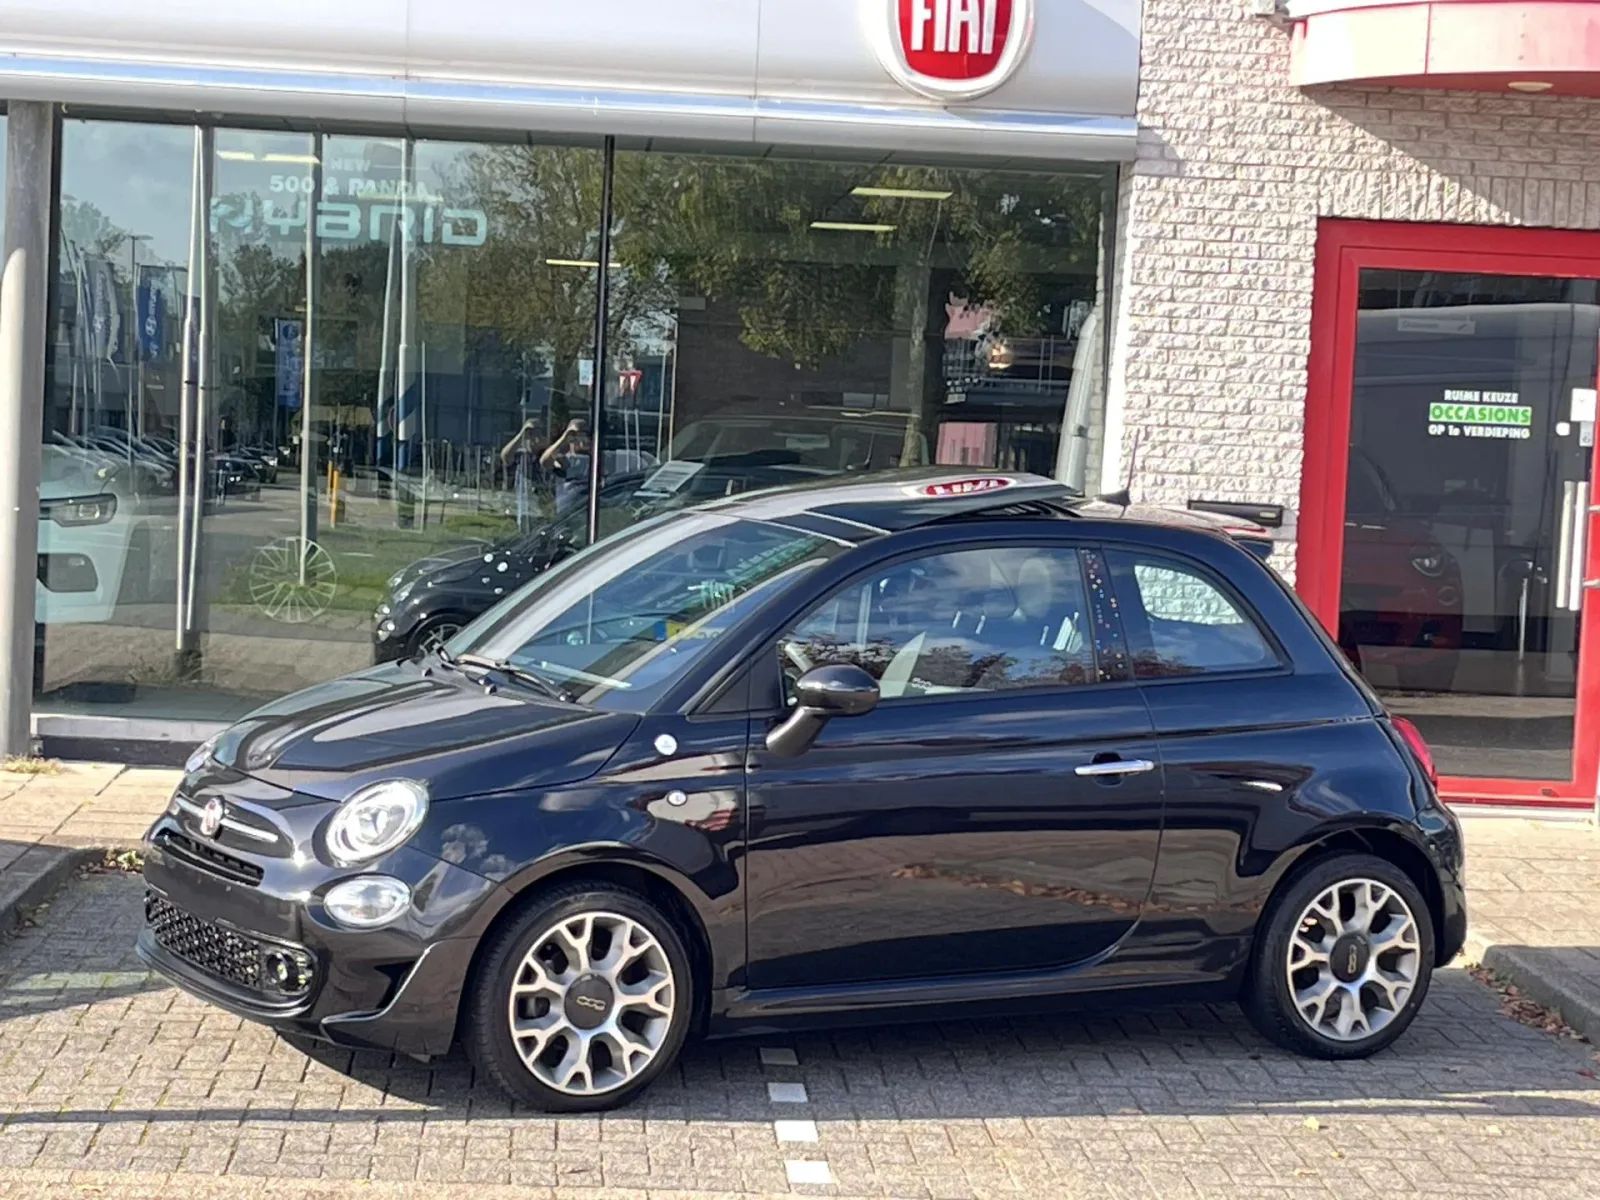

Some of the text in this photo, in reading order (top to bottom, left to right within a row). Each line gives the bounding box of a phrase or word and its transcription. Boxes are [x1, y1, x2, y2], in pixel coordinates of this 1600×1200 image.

[911, 0, 997, 54] FIAT
[331, 157, 371, 172] NEW
[269, 174, 429, 200] 500 & PANDA
[1444, 389, 1519, 403] RUIME KEUZE
[1431, 404, 1529, 423] OCCASIONS
[1428, 424, 1445, 435] OP
[1463, 425, 1530, 439] VERDIEPING
